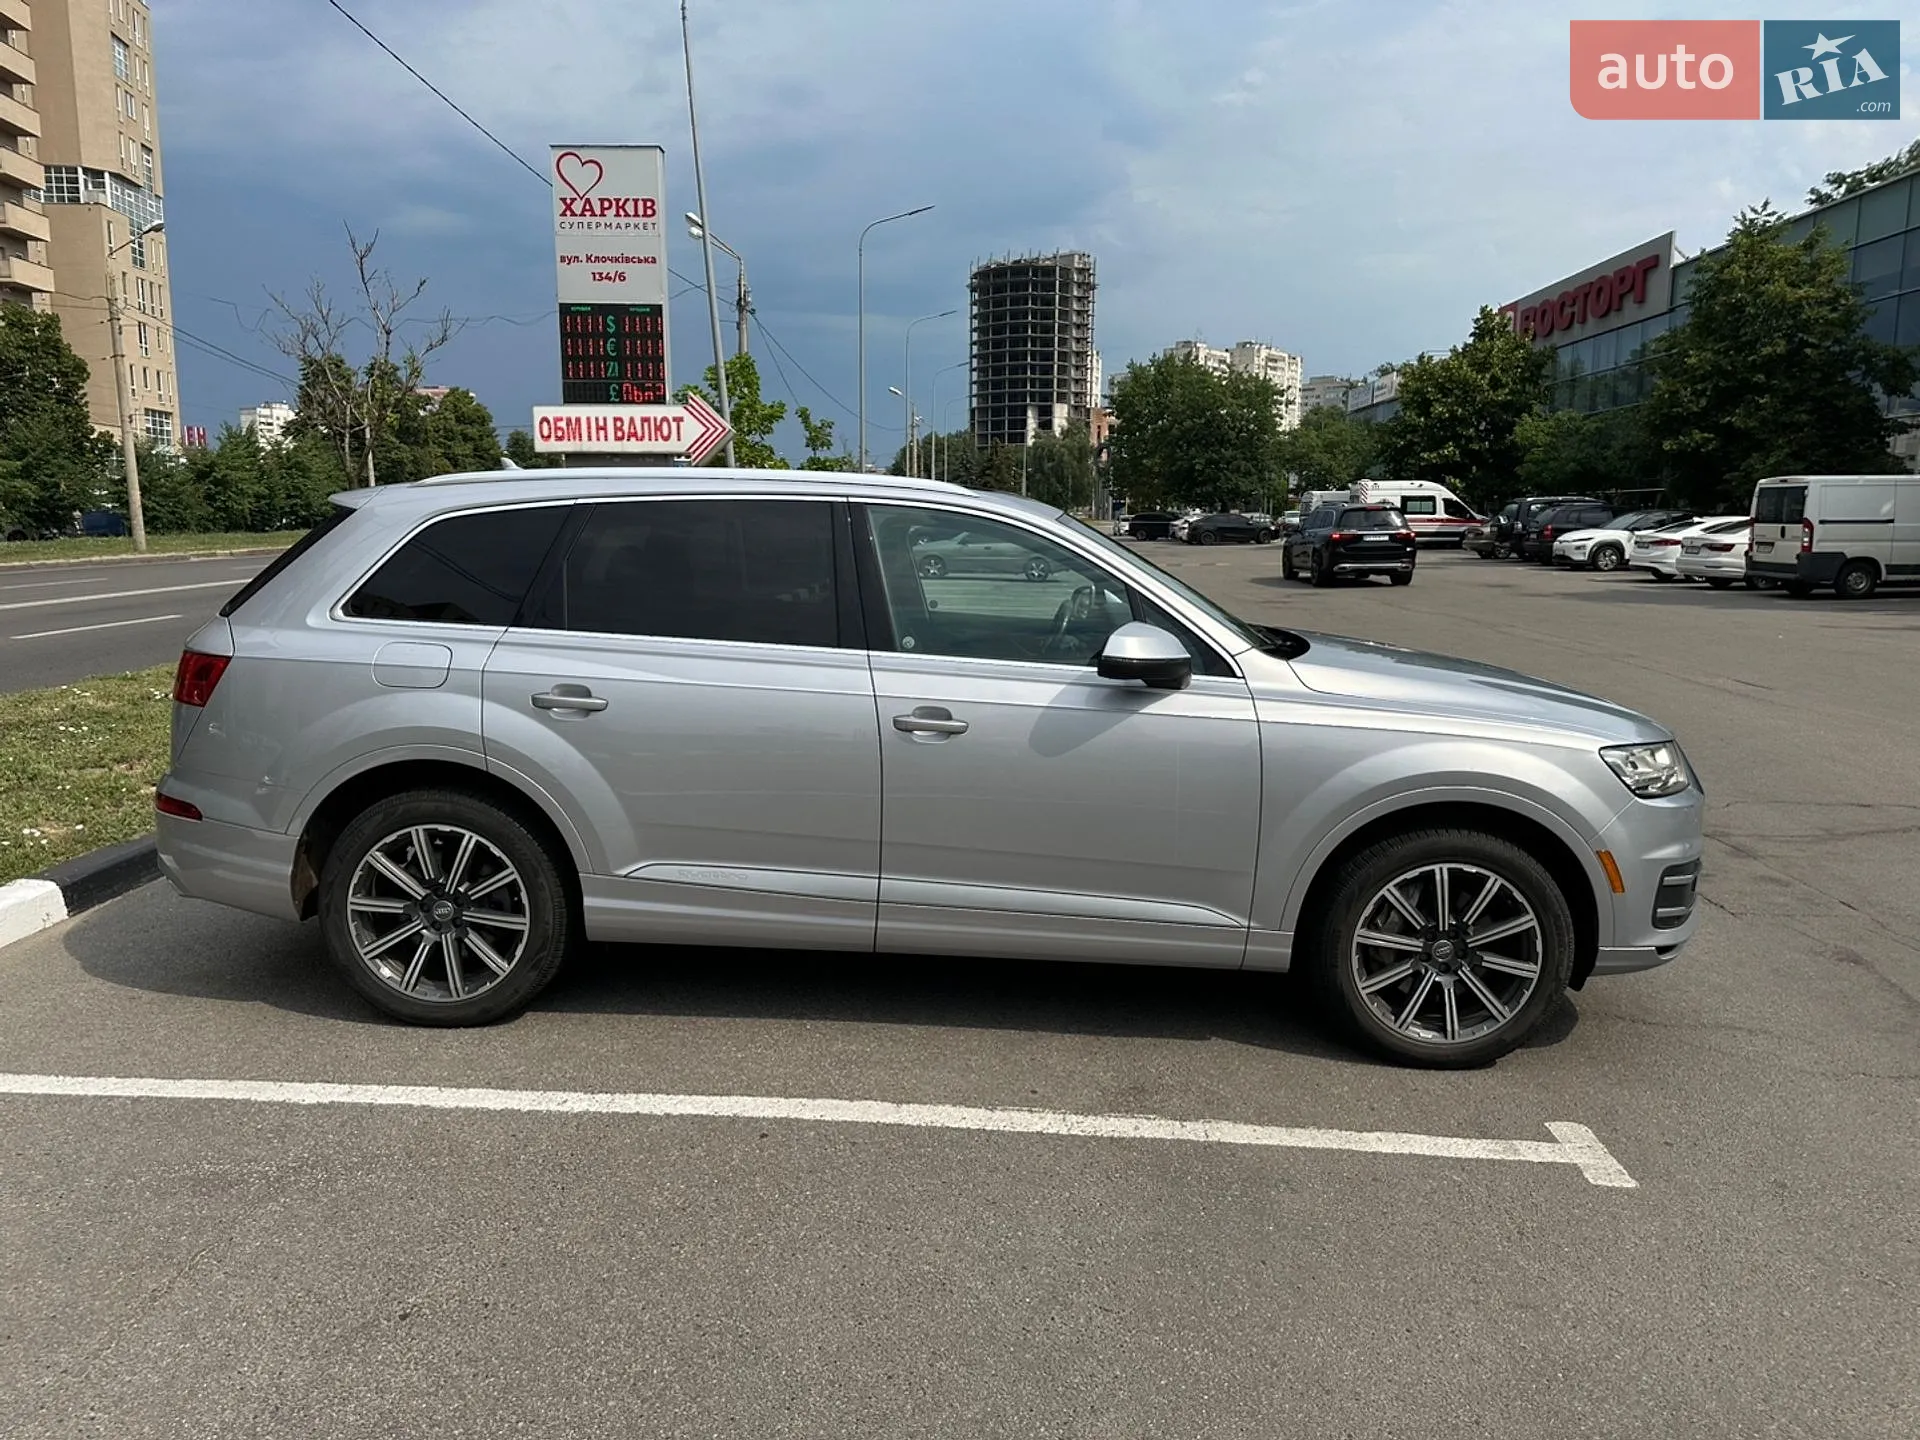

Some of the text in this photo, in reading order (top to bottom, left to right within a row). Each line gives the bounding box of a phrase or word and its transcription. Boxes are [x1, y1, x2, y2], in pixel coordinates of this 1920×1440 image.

[559, 197, 657, 218] ХАРКІВ
[559, 221, 657, 231] СУПЕРМАРКЕТ
[560, 252, 657, 265] вул. Клочківська
[591, 271, 627, 283] 134/6
[539, 416, 684, 443] ОБМІН ВАЛЮТ
